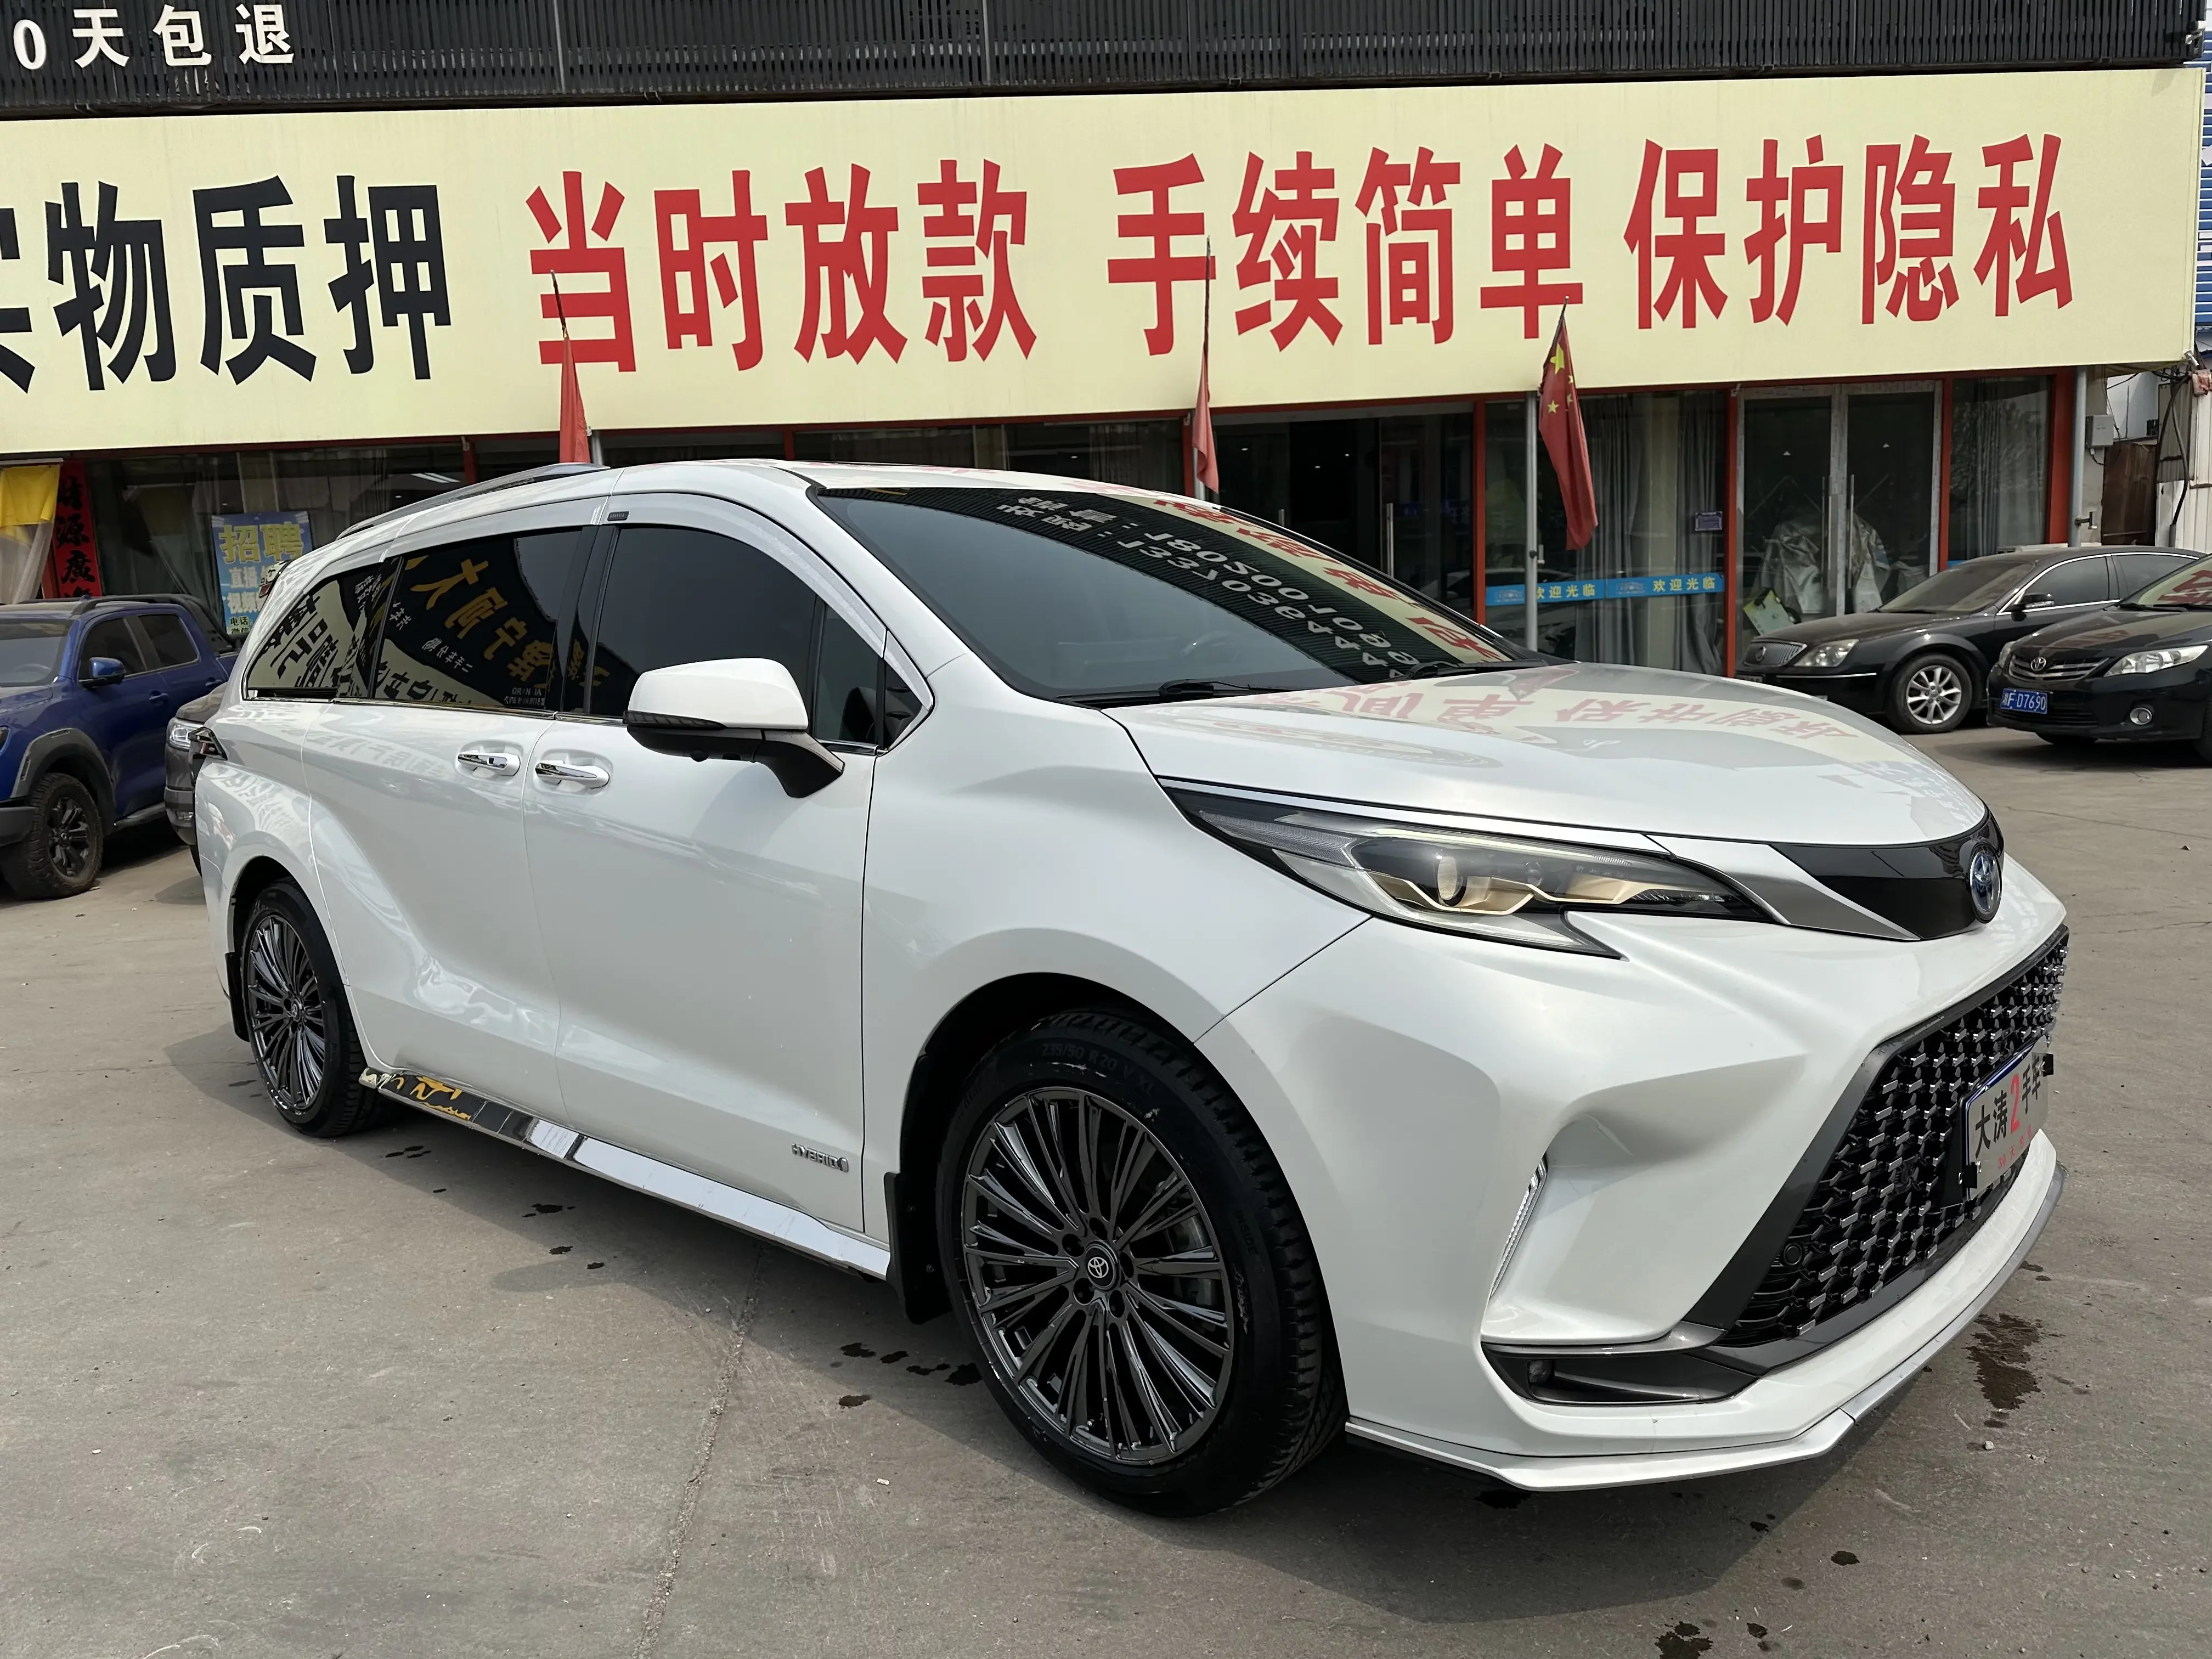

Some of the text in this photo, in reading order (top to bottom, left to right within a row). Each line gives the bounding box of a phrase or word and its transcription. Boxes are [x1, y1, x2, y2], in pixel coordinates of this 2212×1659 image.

[13, 4, 294, 70] 0天包退
[525, 159, 1037, 372] 当时放款
[1107, 143, 1583, 356] 手续简单
[1623, 133, 2073, 330] 保护隐私
[219, 521, 304, 565] 招聘
[228, 566, 267, 589] 直播
[1652, 576, 1716, 592] 欢迎光临
